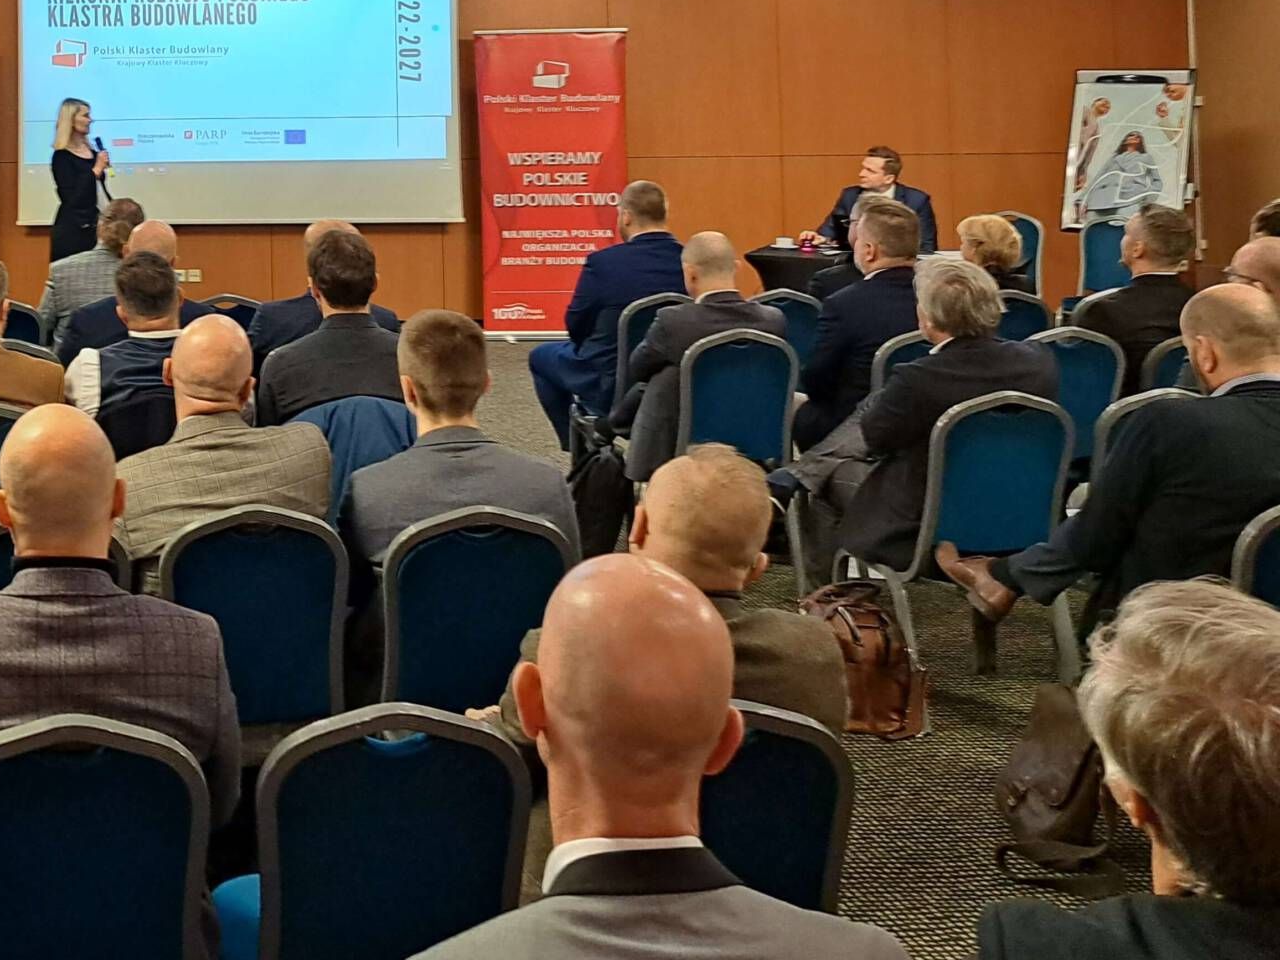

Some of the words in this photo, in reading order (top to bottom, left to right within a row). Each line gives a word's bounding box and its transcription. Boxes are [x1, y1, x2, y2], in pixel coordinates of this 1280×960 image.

[48, 4, 124, 28] KLASTRA
[131, 2, 257, 27] BUDOWLANEGO
[93, 45, 125, 56] Polski
[128, 45, 166, 56] Klaster
[170, 44, 230, 57] Budowlany
[484, 94, 518, 103] Polski
[519, 94, 557, 102] Klaster
[560, 93, 620, 103] Budowlany
[195, 129, 227, 140] PARP
[507, 152, 602, 166] WSPIERAMY
[523, 172, 589, 186] POLSKIE
[493, 193, 619, 207] BUDOWNICTWO
[571, 229, 614, 238] POLSKA
[522, 243, 597, 252] ORGANIZACJA
[501, 255, 544, 265] BRANŻY
[546, 256, 588, 265] BUDOW
